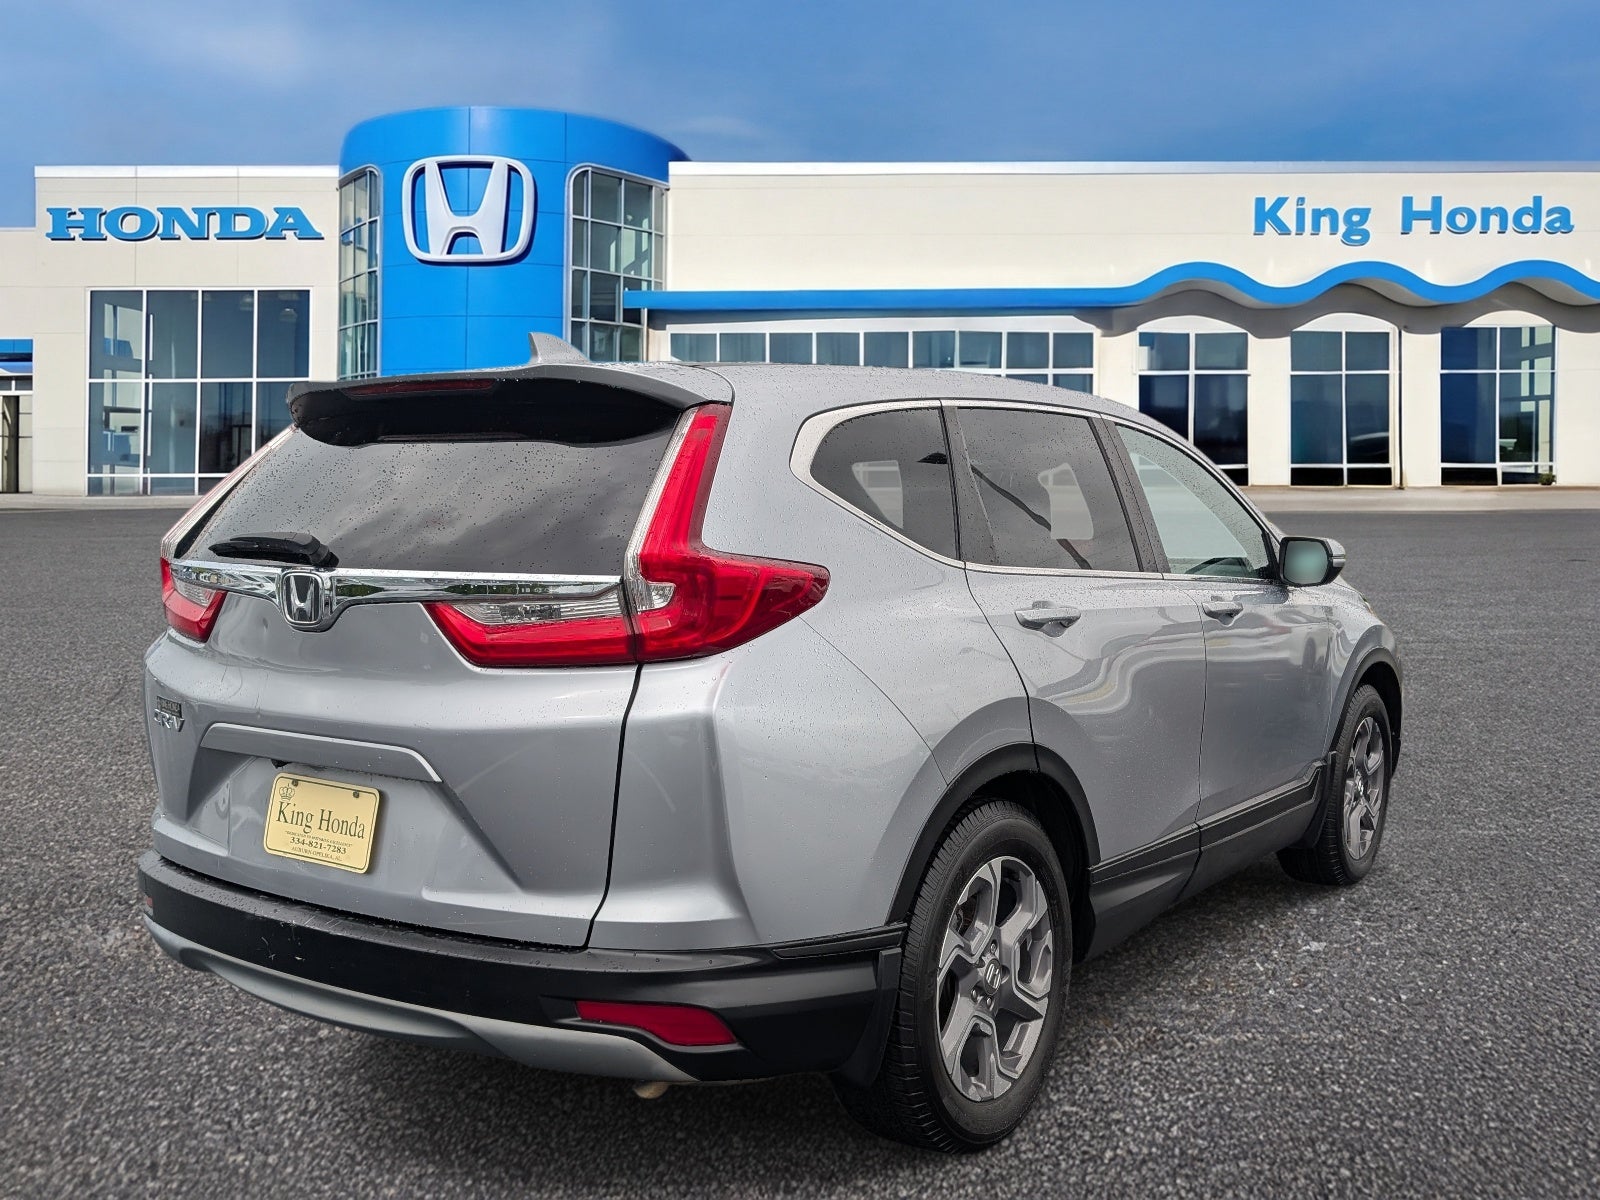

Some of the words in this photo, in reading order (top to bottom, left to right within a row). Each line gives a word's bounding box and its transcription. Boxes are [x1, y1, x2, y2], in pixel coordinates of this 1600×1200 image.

[45, 206, 324, 241] HONDA
[1253, 196, 1372, 247] King
[1400, 195, 1575, 235] Honda
[276, 801, 314, 834] King
[318, 808, 365, 840] Honda
[289, 836, 347, 855] 334-821-7283
